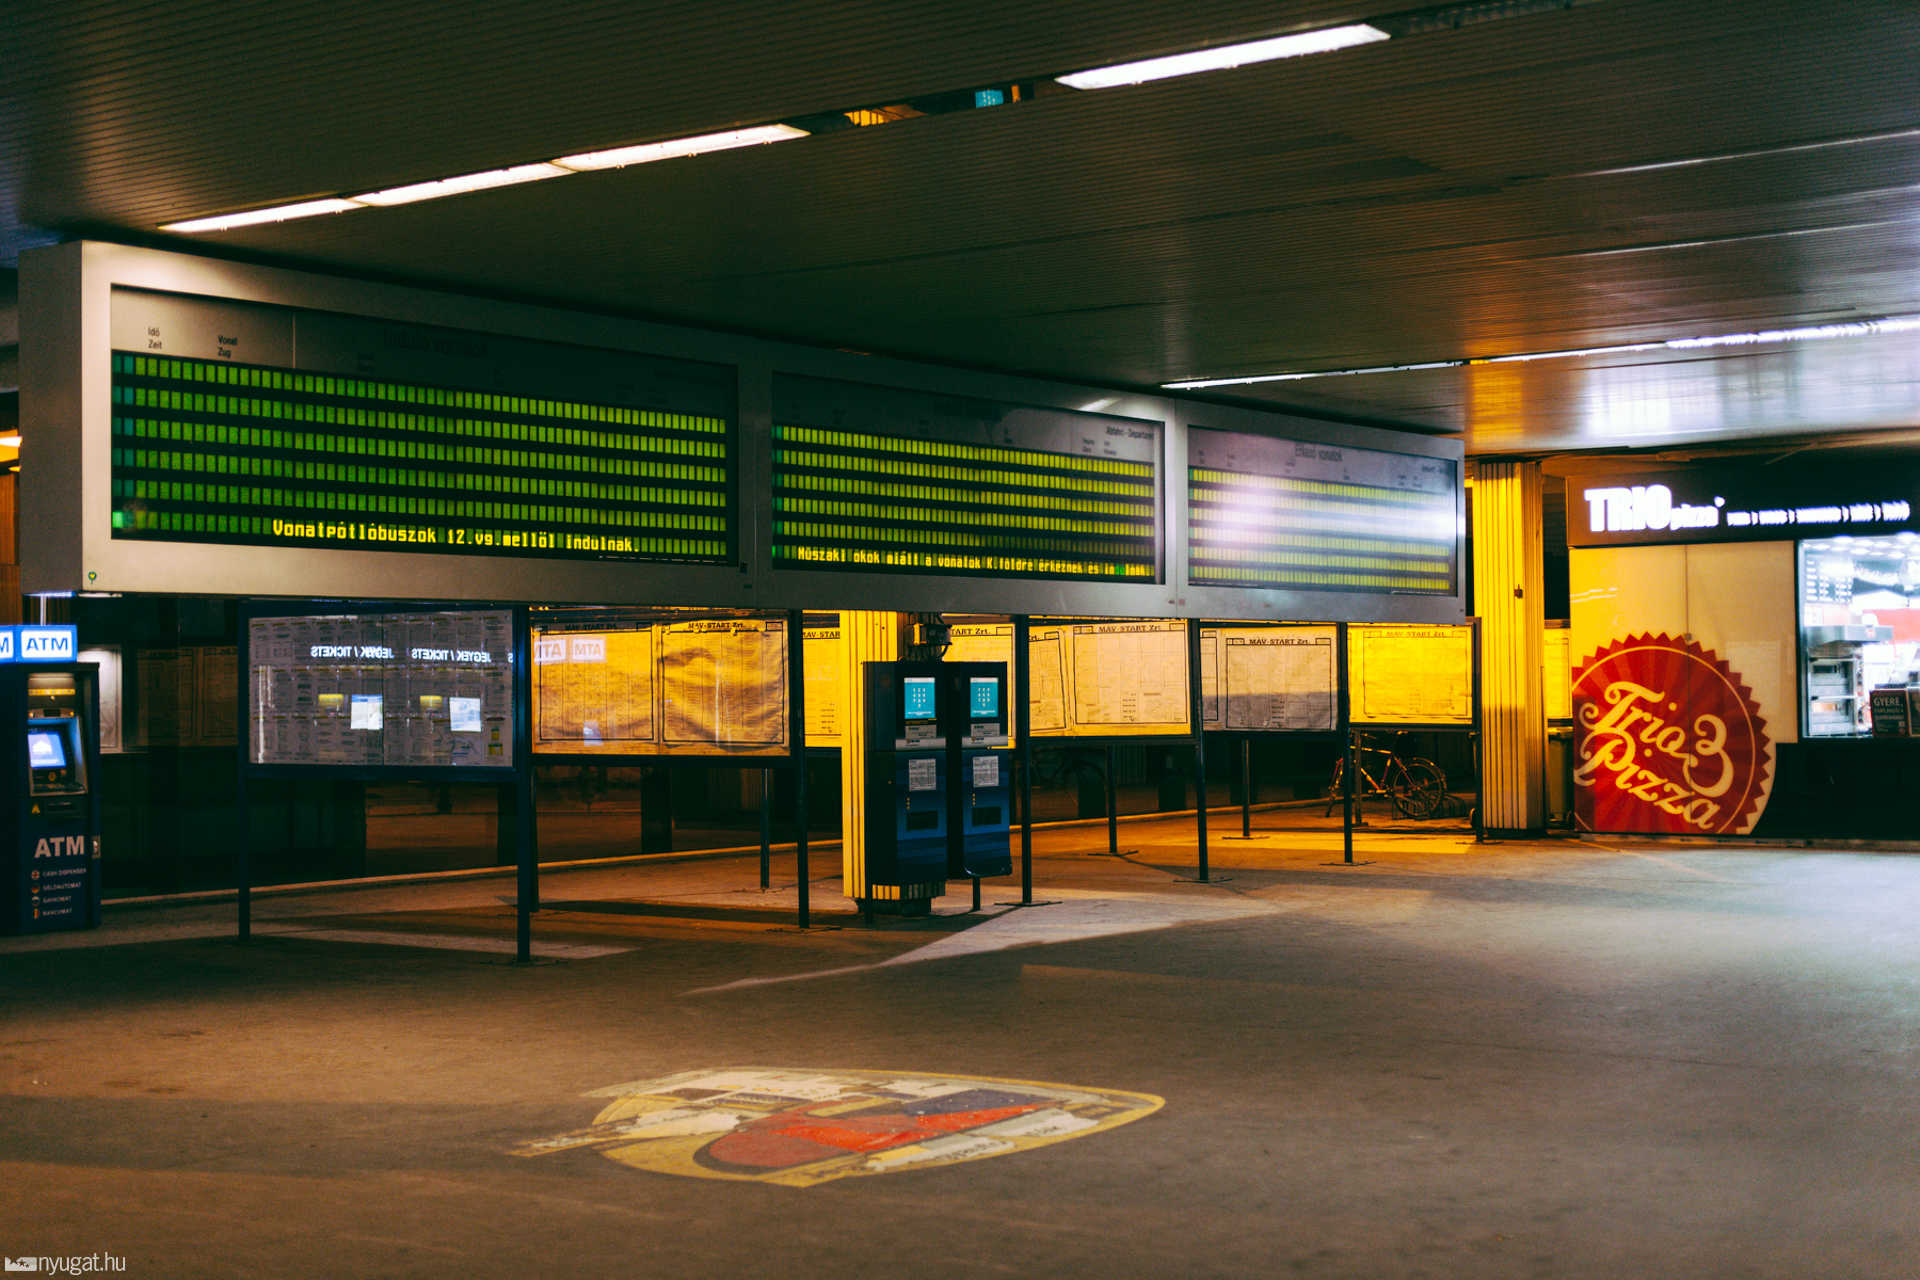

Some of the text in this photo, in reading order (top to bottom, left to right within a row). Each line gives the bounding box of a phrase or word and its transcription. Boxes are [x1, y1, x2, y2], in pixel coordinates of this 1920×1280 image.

[1583, 485, 1671, 532] TRIO
[272, 519, 437, 543] Vonatpótlóbuszok
[852, 550, 880, 564] okok
[925, 556, 932, 567] a
[26, 637, 68, 651] ATM
[1580, 680, 1699, 770] Trio
[1574, 732, 1722, 830] Pizza
[33, 835, 85, 859] ATM
